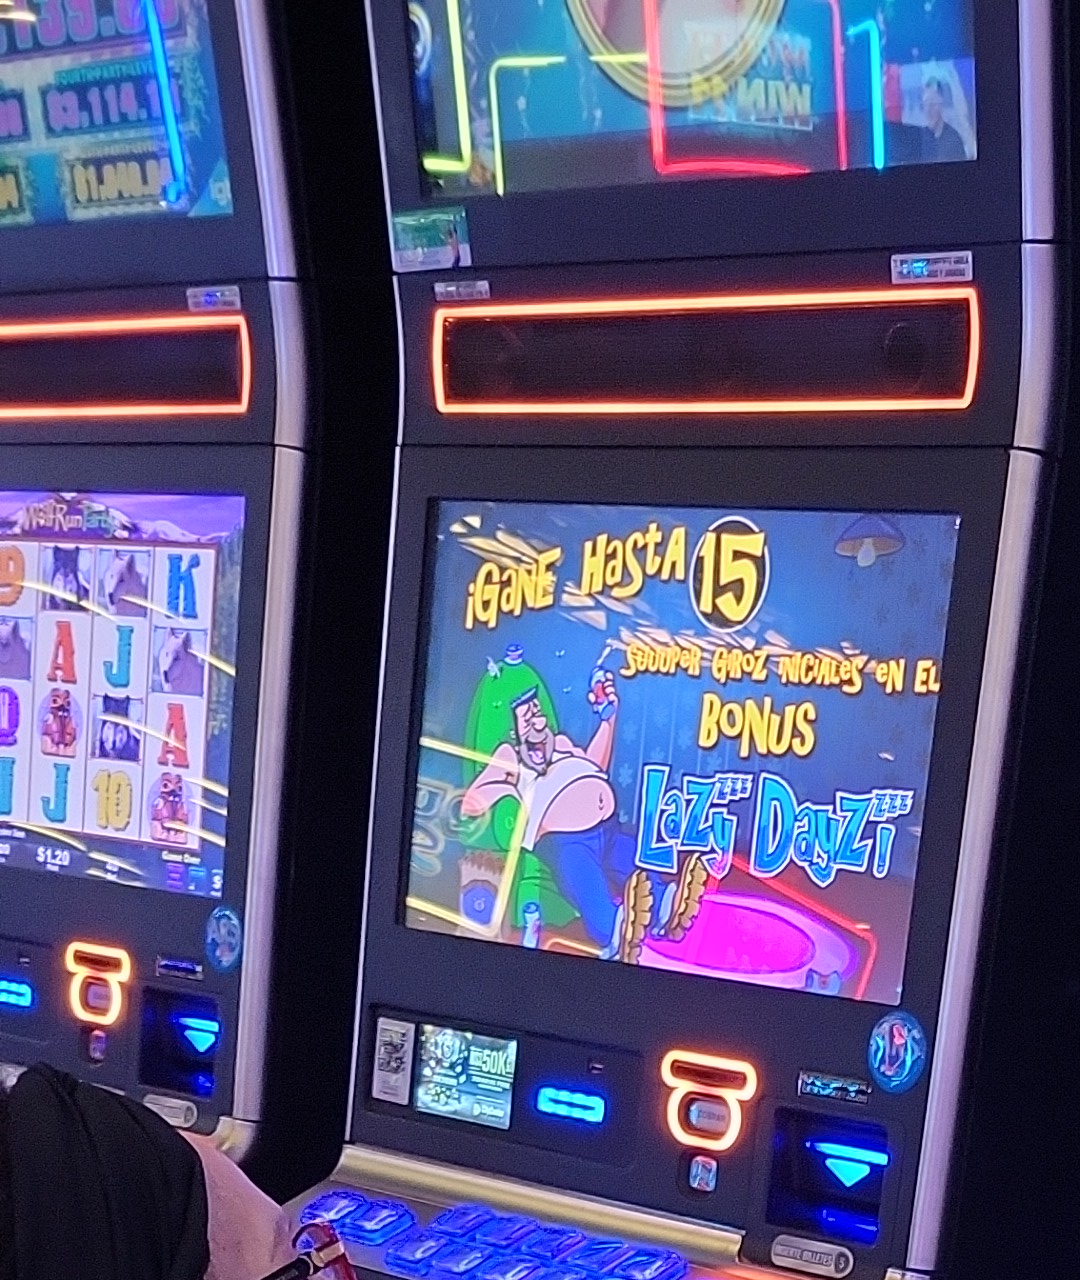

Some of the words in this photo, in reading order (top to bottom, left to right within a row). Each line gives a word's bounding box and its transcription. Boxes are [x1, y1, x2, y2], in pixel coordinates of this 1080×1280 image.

[165, 553, 201, 620] K
[698, 531, 766, 622] 15
[47, 621, 77, 684] A
[102, 625, 135, 688] J
[914, 659, 942, 694] EL
[158, 703, 190, 768] A
[40, 763, 71, 823] J
[91, 769, 133, 831] 10
[36, 846, 70, 867] $1.20
